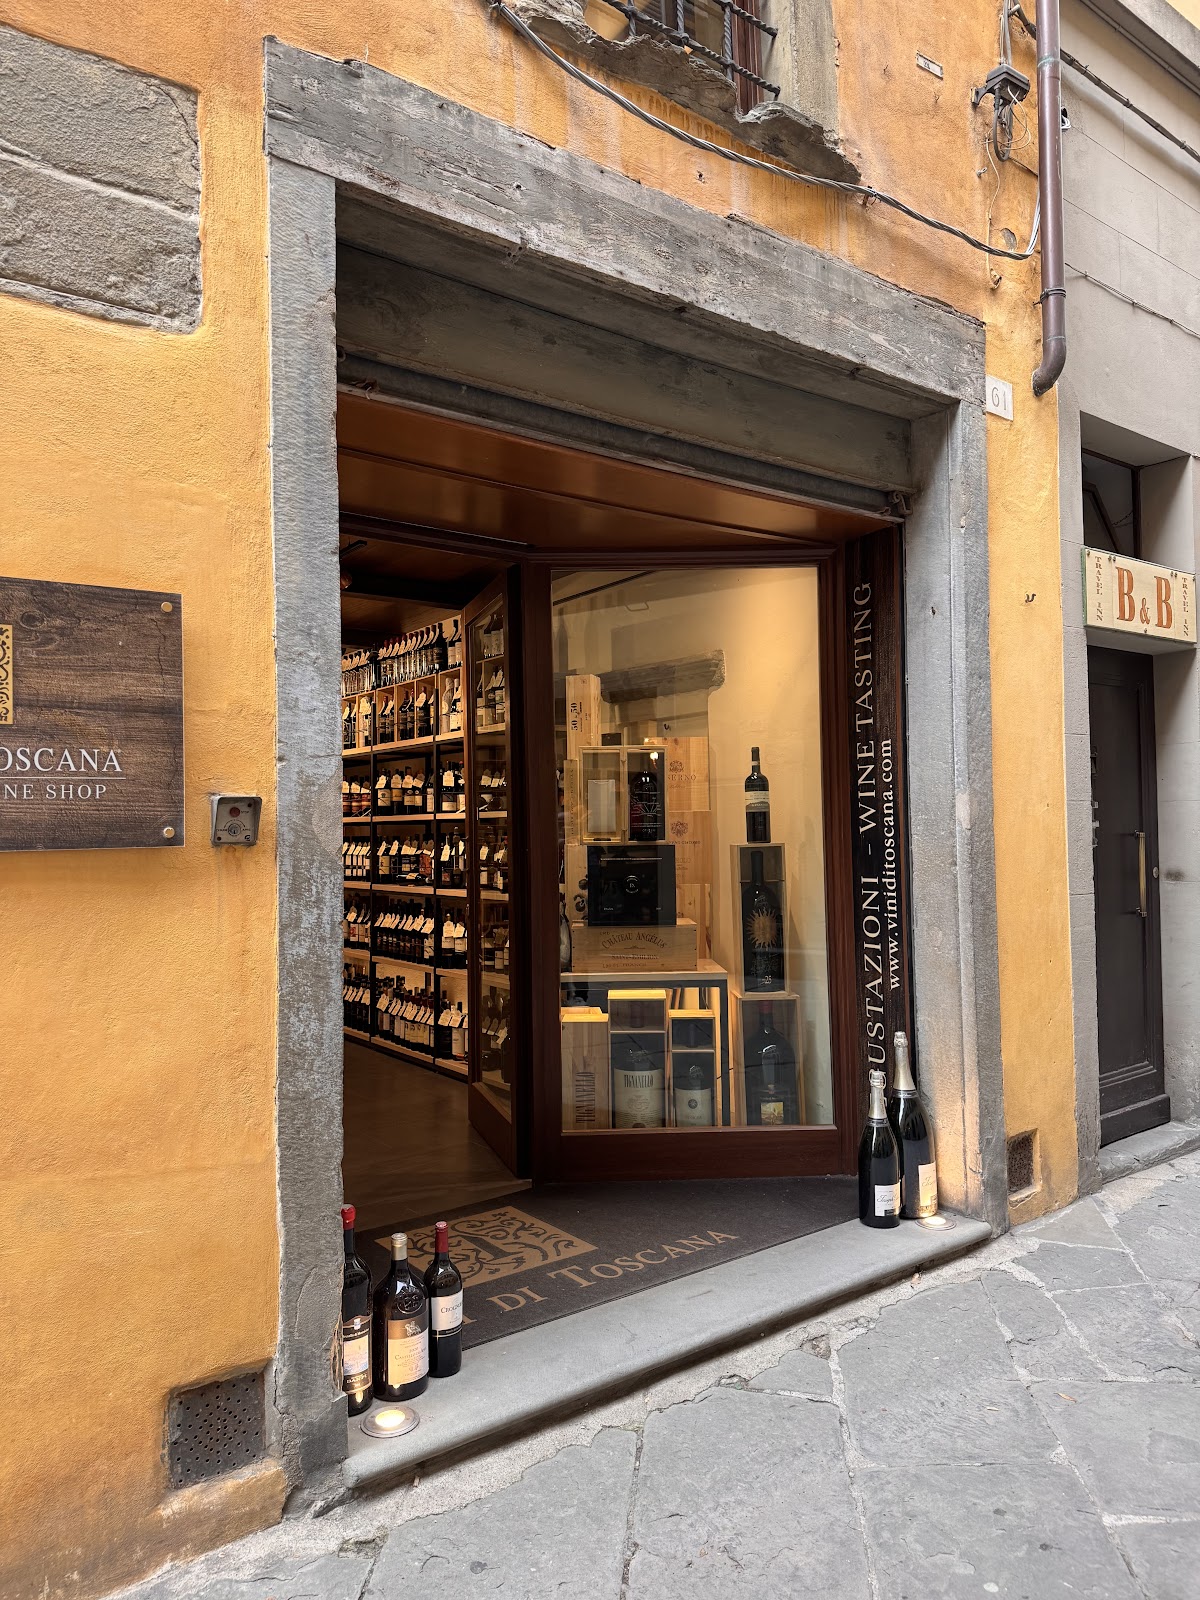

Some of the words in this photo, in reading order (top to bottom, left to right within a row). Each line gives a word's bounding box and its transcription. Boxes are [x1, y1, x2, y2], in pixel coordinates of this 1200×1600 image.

[991, 386, 1007, 411] 61
[853, 583, 874, 733] TASTING
[46, 784, 107, 799] SHOP
[857, 740, 877, 835] WINE
[881, 738, 901, 991] www.viniditoscana.com
[485, 1285, 548, 1312] DI
[549, 1229, 740, 1289] TOSCANA
